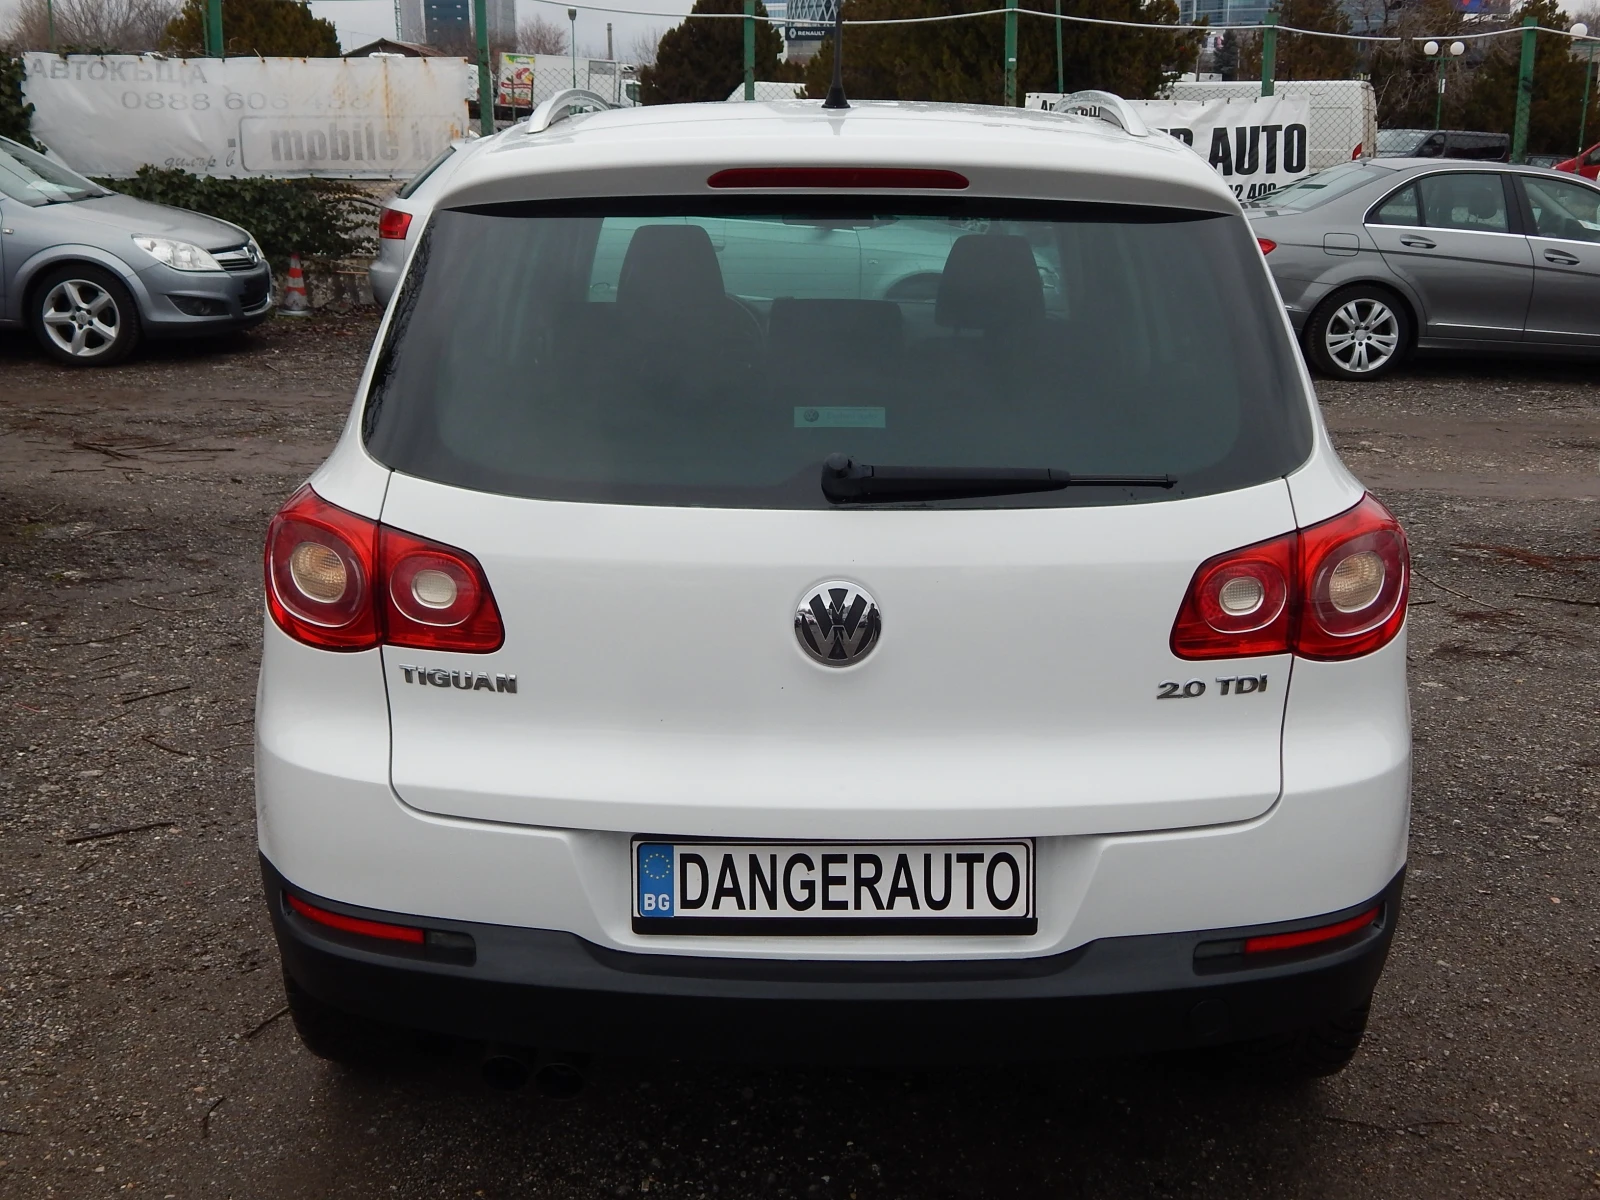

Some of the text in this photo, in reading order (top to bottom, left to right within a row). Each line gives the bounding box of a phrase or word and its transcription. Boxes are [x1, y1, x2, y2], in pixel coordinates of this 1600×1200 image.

[28, 58, 208, 87] АВТОКЪЩА
[121, 91, 211, 111] 0888
[269, 122, 399, 161] mobile
[1208, 123, 1307, 176] AUTO
[398, 663, 518, 694] TIGUAN
[1215, 673, 1268, 696] TDI
[643, 851, 1021, 911] BG DANGERAUTO
